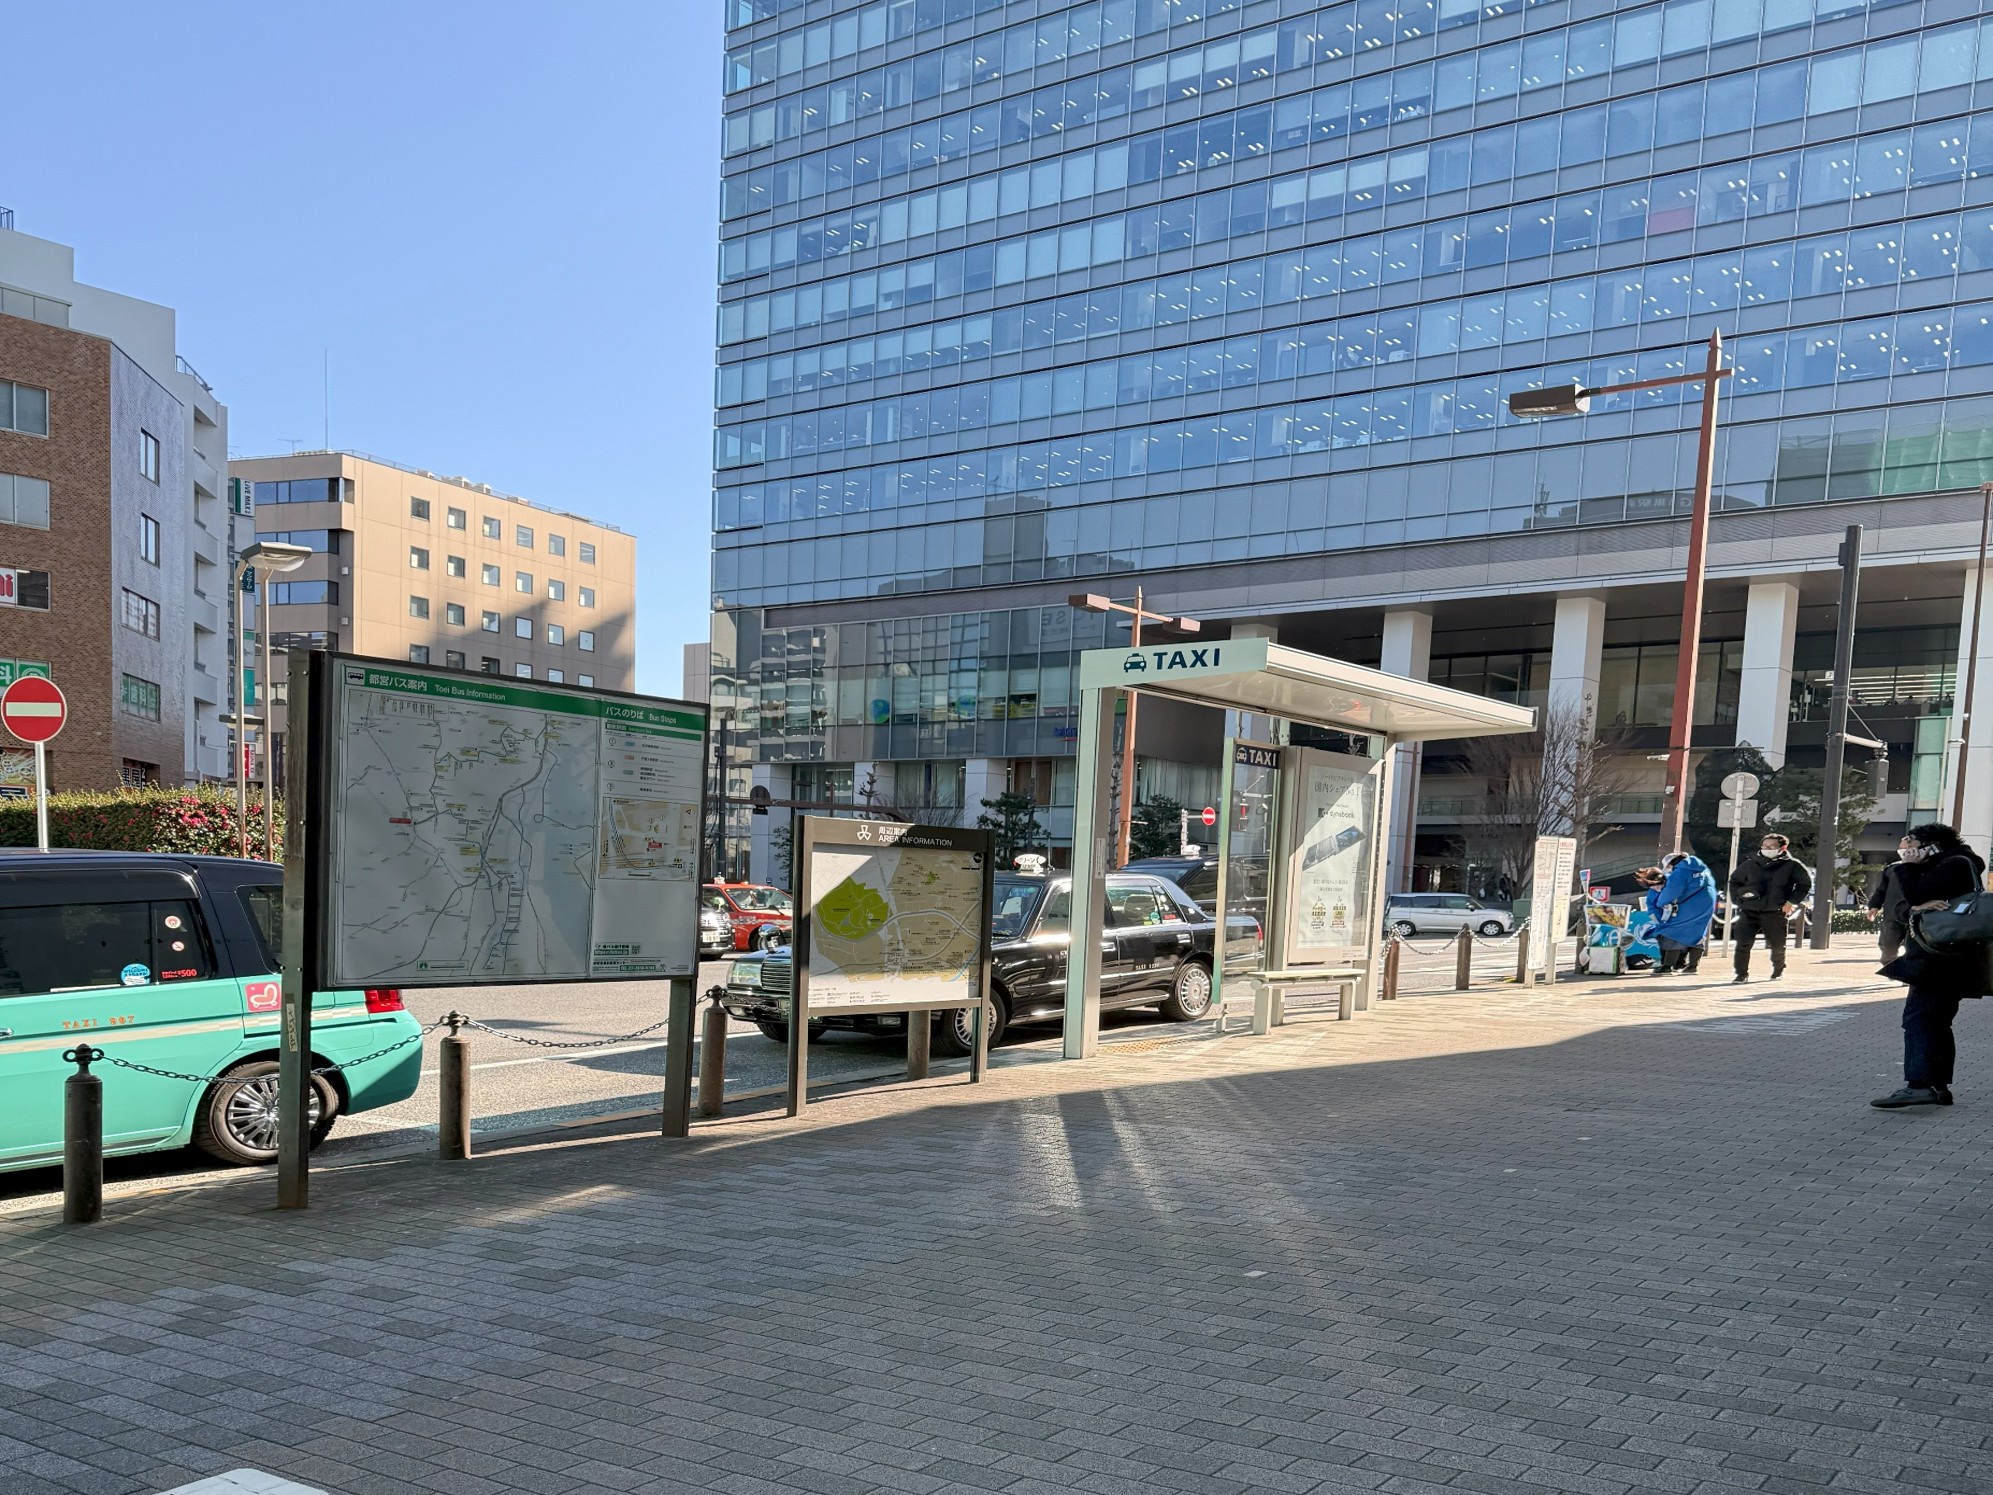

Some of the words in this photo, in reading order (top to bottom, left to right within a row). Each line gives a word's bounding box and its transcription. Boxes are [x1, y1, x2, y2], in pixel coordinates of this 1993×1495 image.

[1153, 648, 1220, 670] TAXI
[368, 673, 428, 692] 都営バス案内
[435, 684, 450, 694] Toei
[451, 686, 465, 696] Bus
[466, 688, 506, 701] Information
[605, 706, 645, 720] バスのりば
[649, 713, 659, 722] Bus
[660, 715, 677, 724] Stops
[1248, 748, 1278, 768] TAXI
[878, 835, 900, 843] AREA
[901, 837, 953, 847] INFORMATION
[62, 1019, 97, 1030] TAXI
[109, 1015, 135, 1025] 907
